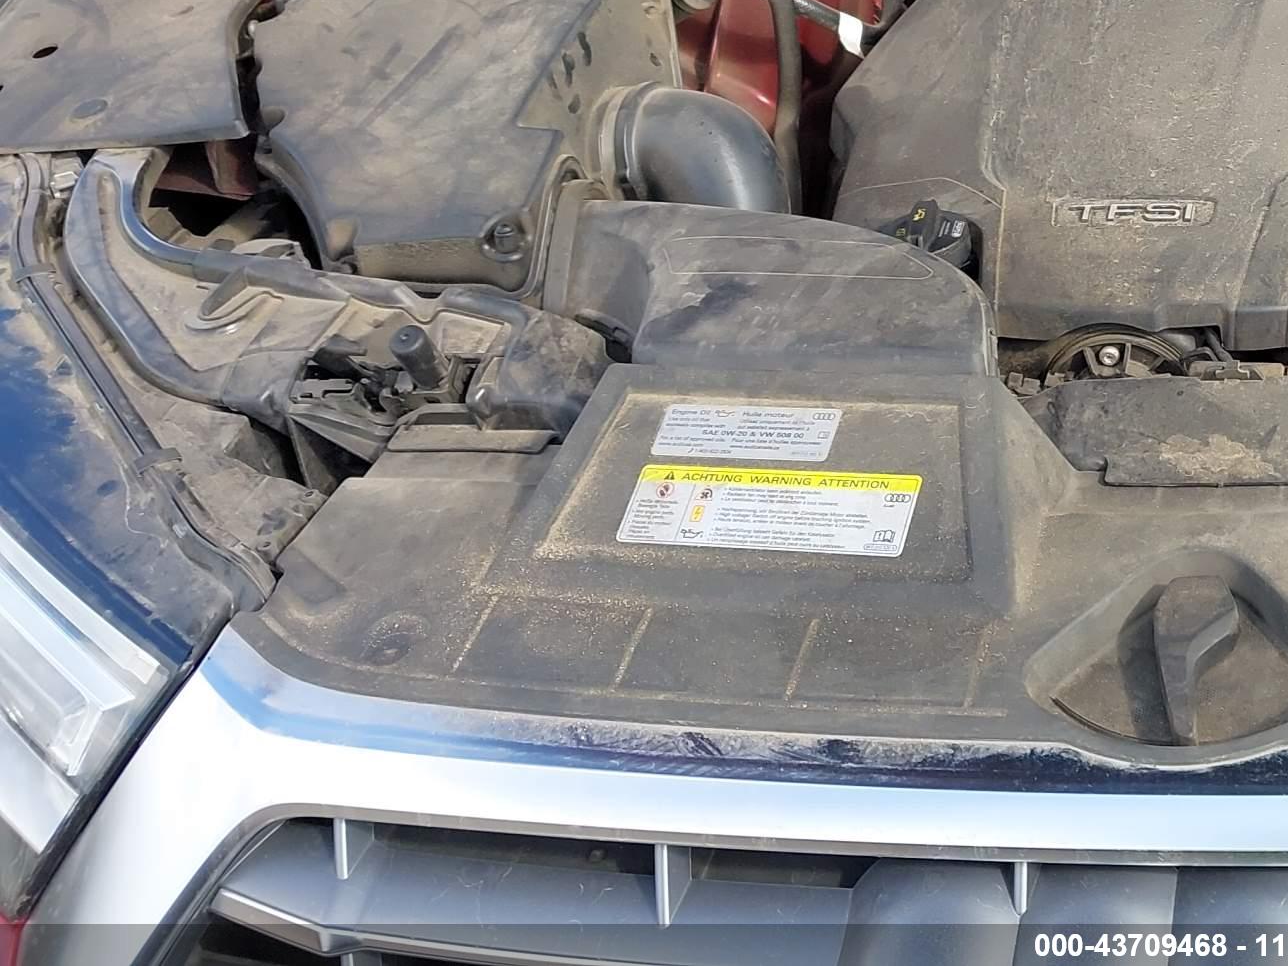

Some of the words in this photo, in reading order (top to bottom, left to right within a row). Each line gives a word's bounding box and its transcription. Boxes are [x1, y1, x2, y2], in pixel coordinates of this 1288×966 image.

[1067, 202, 1194, 224] TFSI
[681, 473, 743, 483] ACHTUNG
[750, 475, 812, 486] WARNING
[818, 478, 890, 490] ATTENTION
